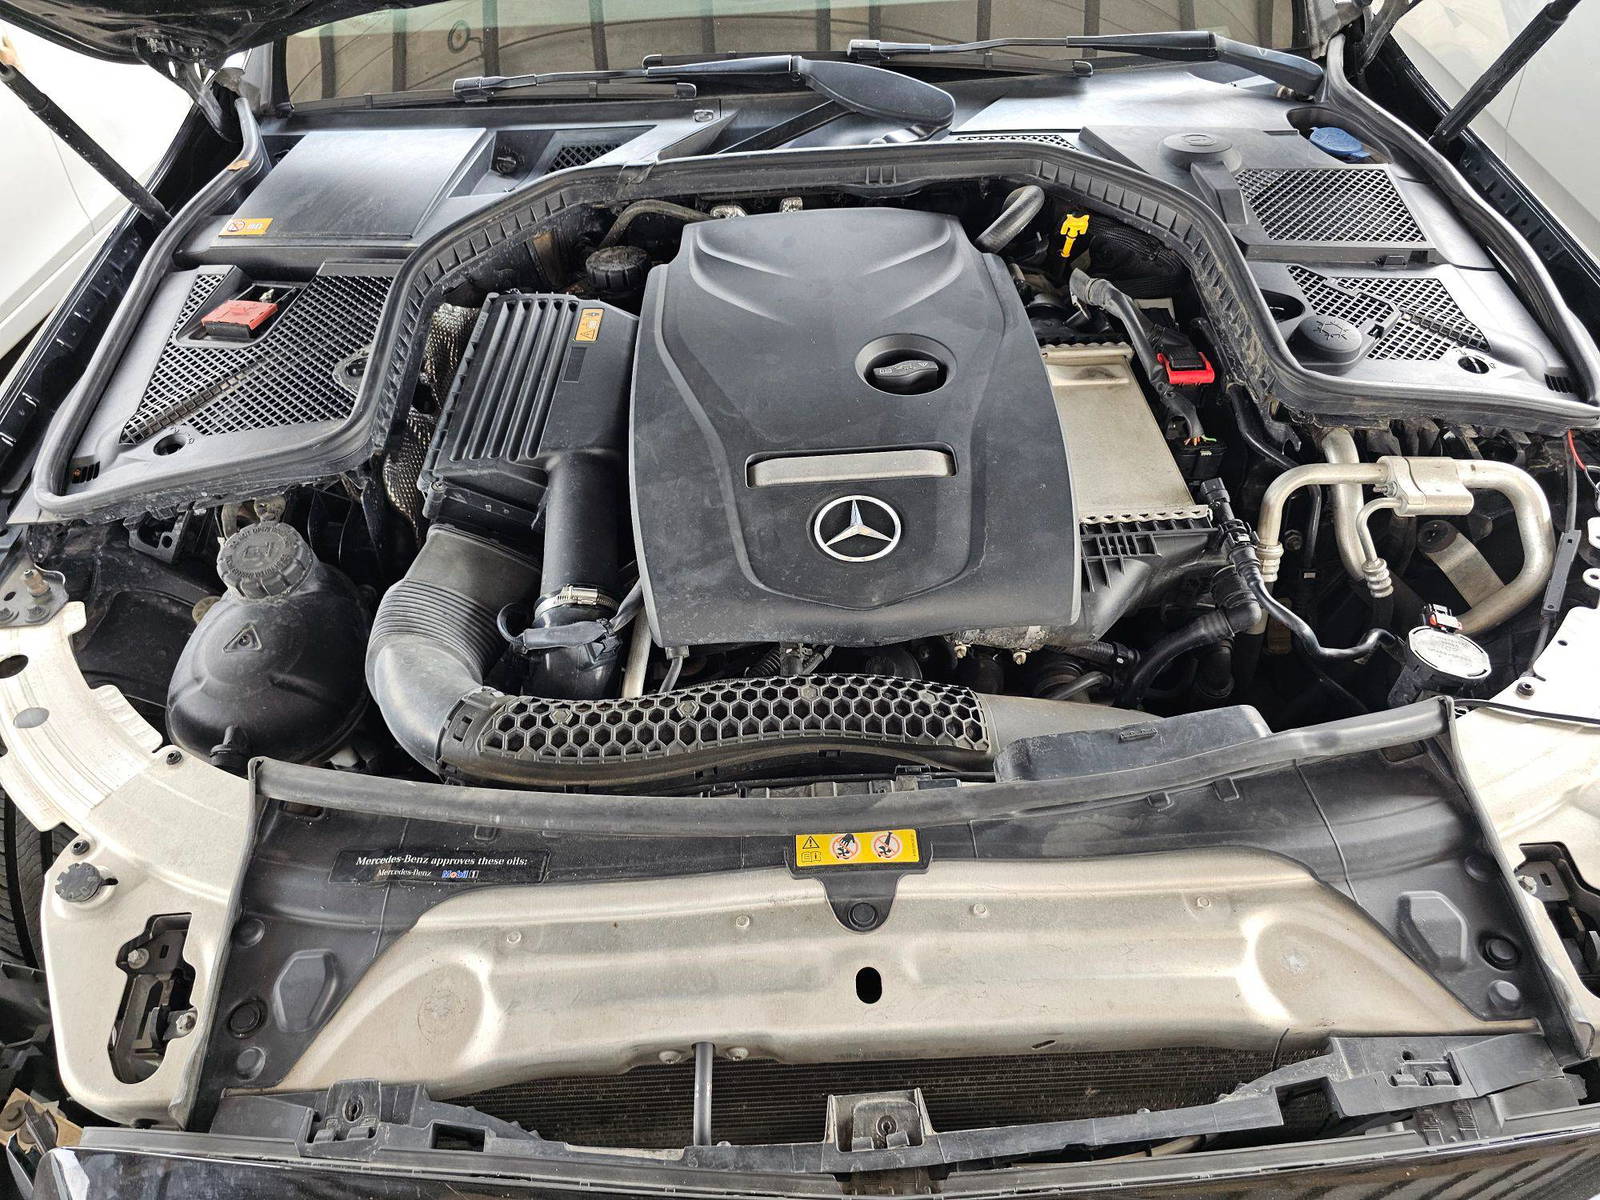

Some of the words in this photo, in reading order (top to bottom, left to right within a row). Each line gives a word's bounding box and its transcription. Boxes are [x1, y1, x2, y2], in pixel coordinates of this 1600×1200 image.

[356, 854, 429, 866] Mercedes-Benz
[430, 856, 475, 867] approves
[478, 856, 505, 866] these
[376, 868, 432, 877] Mercedes-Benz
[441, 869, 469, 879] Mobil
